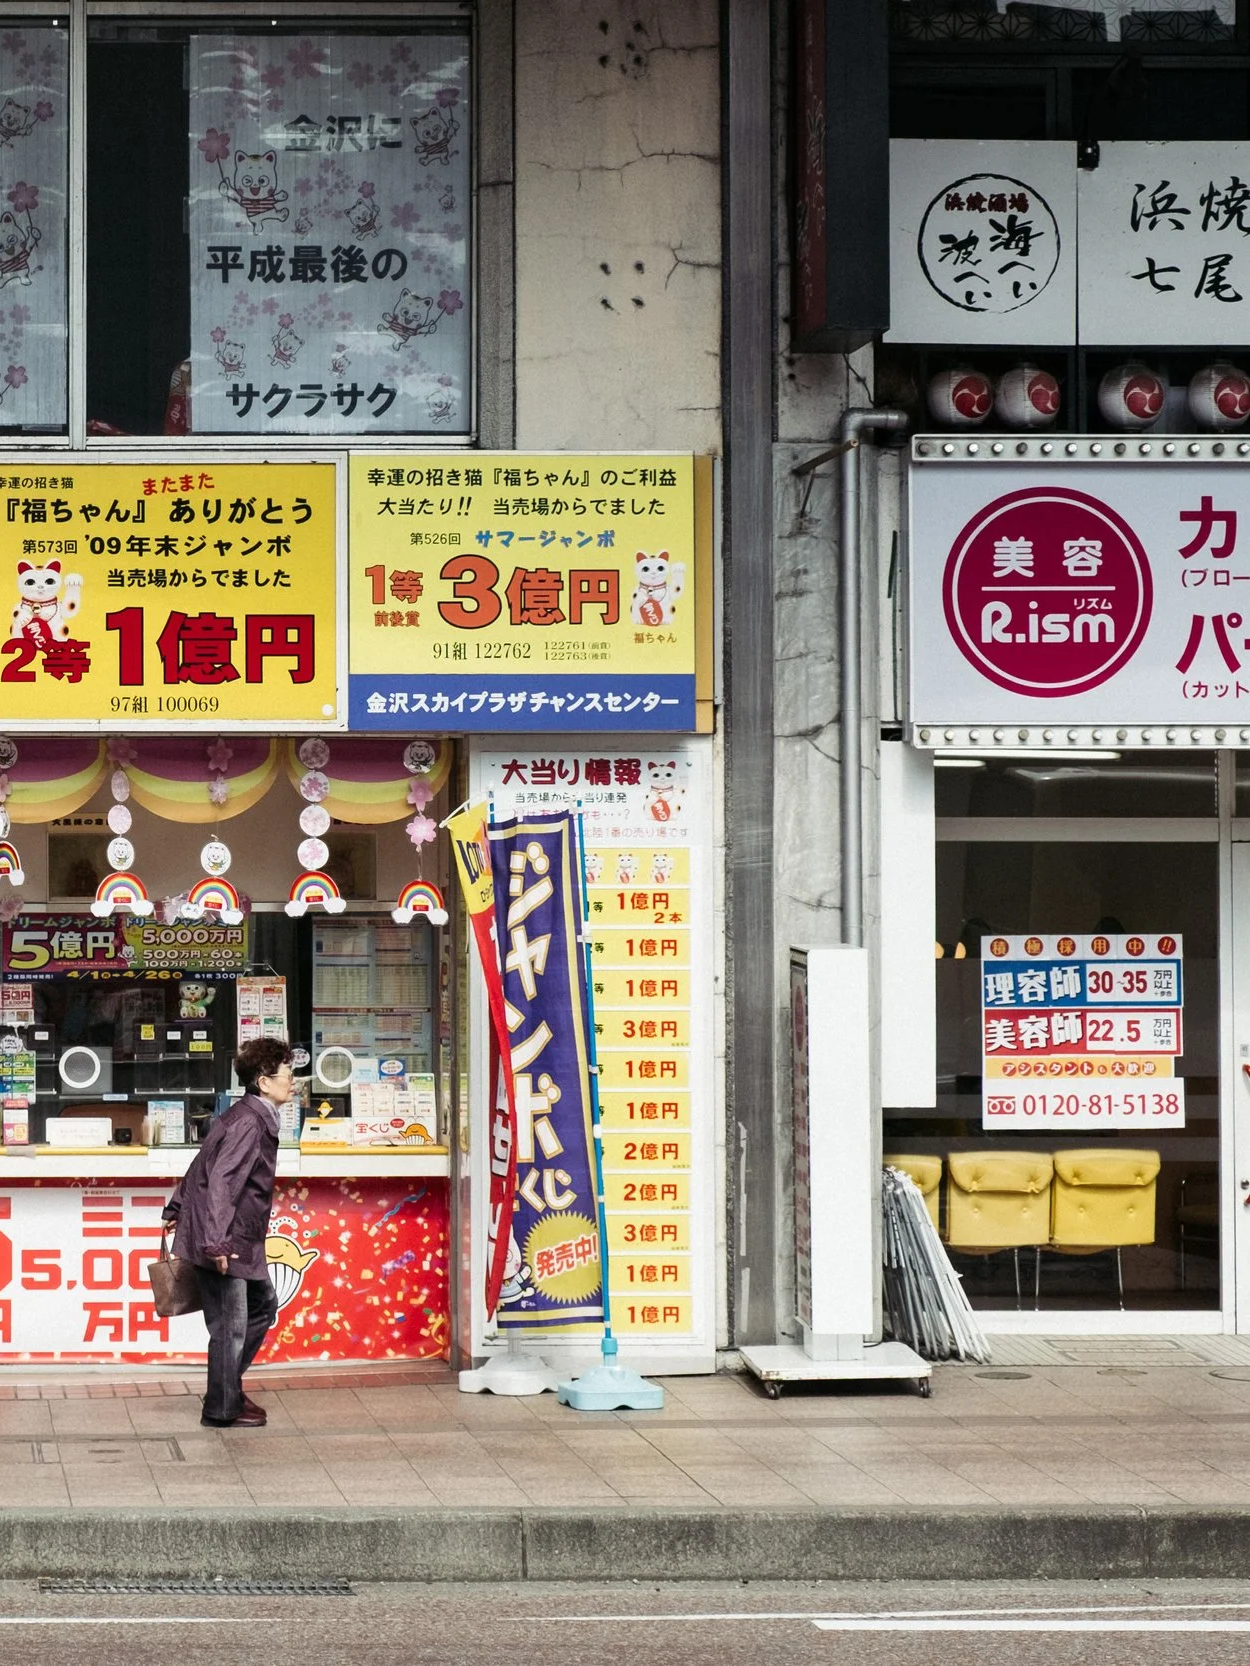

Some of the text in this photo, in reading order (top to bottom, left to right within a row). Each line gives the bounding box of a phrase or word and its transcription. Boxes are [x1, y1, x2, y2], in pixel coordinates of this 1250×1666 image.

[283, 114, 402, 152] 金沢に
[206, 245, 408, 283] 平成最後の
[1131, 253, 1243, 302] 七尾
[226, 383, 398, 419] サクラサク
[142, 473, 215, 495] またまた
[7, 498, 313, 524] 『福ちゃん』 ありがとう
[377, 496, 666, 516] 大当たり!! 当売場からでました
[22, 539, 78, 554] 第573回
[410, 530, 616, 549] 第526回 サマージャンボ
[993, 536, 1103, 578] 美容
[107, 569, 292, 588] 当売場からでました
[364, 554, 620, 630] 1等 3億円
[1074, 598, 1112, 610] リズム
[374, 611, 421, 627] 前後賞
[981, 601, 1115, 643] R.ism
[0, 606, 315, 686] 2等 1億円
[634, 633, 677, 644] 福ちゃん
[1175, 612, 1250, 674] パ
[433, 643, 467, 661] 91組
[476, 643, 531, 660] 122762
[110, 696, 220, 713] 97組 100069
[367, 692, 679, 714] 金沢スカイプラザチャンスセンター
[502, 758, 641, 785] 大当り情報
[617, 893, 669, 910] 1億円
[654, 912, 682, 924] 2本
[8, 930, 116, 969] 5億円
[142, 929, 243, 945] 5,000万円
[626, 939, 677, 956] 1億円
[626, 980, 678, 997] 1億円
[985, 965, 1172, 1005] 理容師 万円
[1154, 980, 1172, 990] 以上
[623, 1020, 677, 1038] 3億円
[985, 1012, 1083, 1051] 美容師
[1153, 1019, 1172, 1028] 万円
[1153, 1029, 1171, 1038] 以上
[625, 1061, 676, 1078] 1億円
[1002, 1061, 1156, 1076] アシスタントも大歓迎
[626, 1102, 678, 1120] 1億円
[1023, 1094, 1179, 1115] 0120-81-5138
[356, 1123, 389, 1134] 宝くじ
[624, 1142, 678, 1161] 2億円
[513, 1167, 578, 1213] くじ
[624, 1183, 677, 1202] 2億円
[624, 1224, 677, 1242] 3億円
[536, 1235, 598, 1279] 発売中!
[627, 1264, 678, 1283] 1億円
[83, 1302, 169, 1343] 万円
[627, 1305, 680, 1324] 1億円
